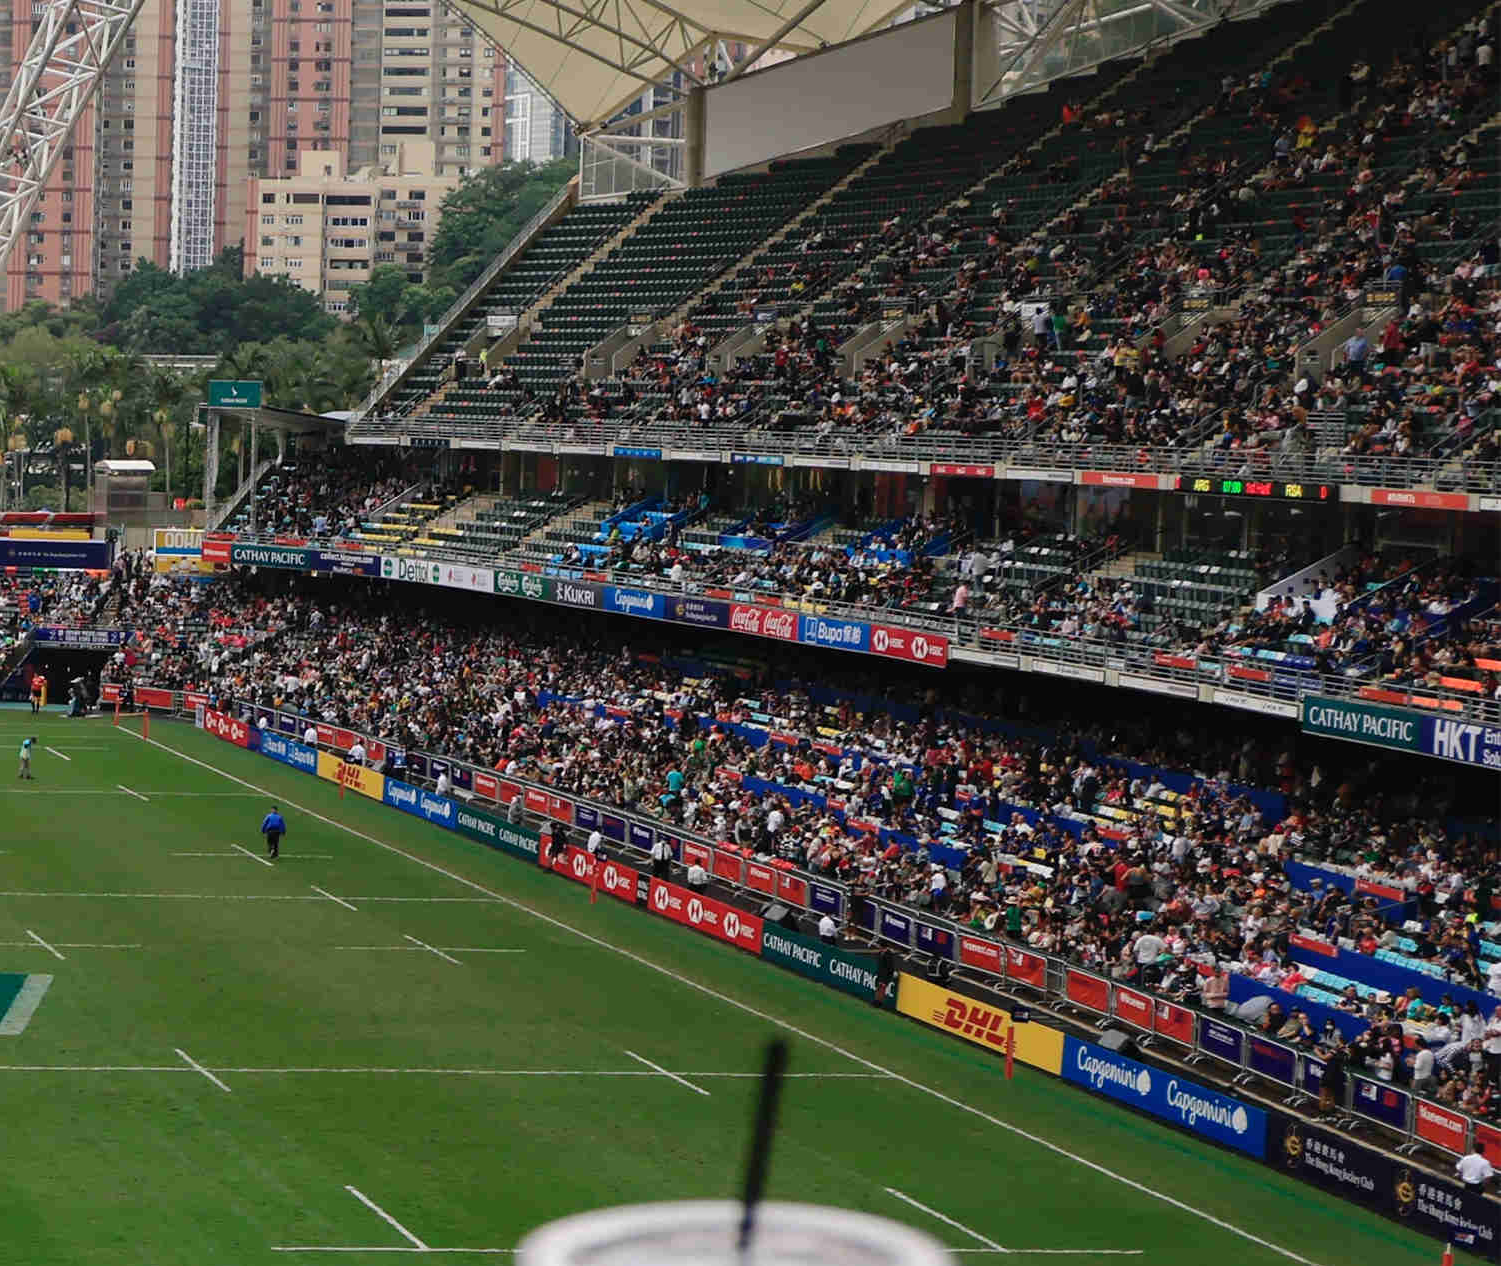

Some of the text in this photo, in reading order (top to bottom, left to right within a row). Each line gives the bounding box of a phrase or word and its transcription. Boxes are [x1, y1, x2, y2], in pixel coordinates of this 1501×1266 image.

[234, 549, 305, 566] CATHAY PACIFIC
[565, 583, 595, 605] KUKRI
[817, 621, 843, 643] Bupa
[1310, 706, 1414, 742] CATHAY PACIFIC
[1433, 719, 1484, 762] HKT
[458, 812, 496, 836] CATHAY PACIFIC
[499, 828, 538, 854] CATHAY PACIFIC
[763, 932, 821, 968] CATHAY PACIFIC
[829, 958, 861, 987] CATHAY
[944, 997, 1008, 1048] DHL
[1077, 1046, 1137, 1089] Capgemini
[1167, 1079, 1232, 1126] Capgemini
[1360, 1176, 1375, 1191] Club
[1478, 1225, 1494, 1241] Club
